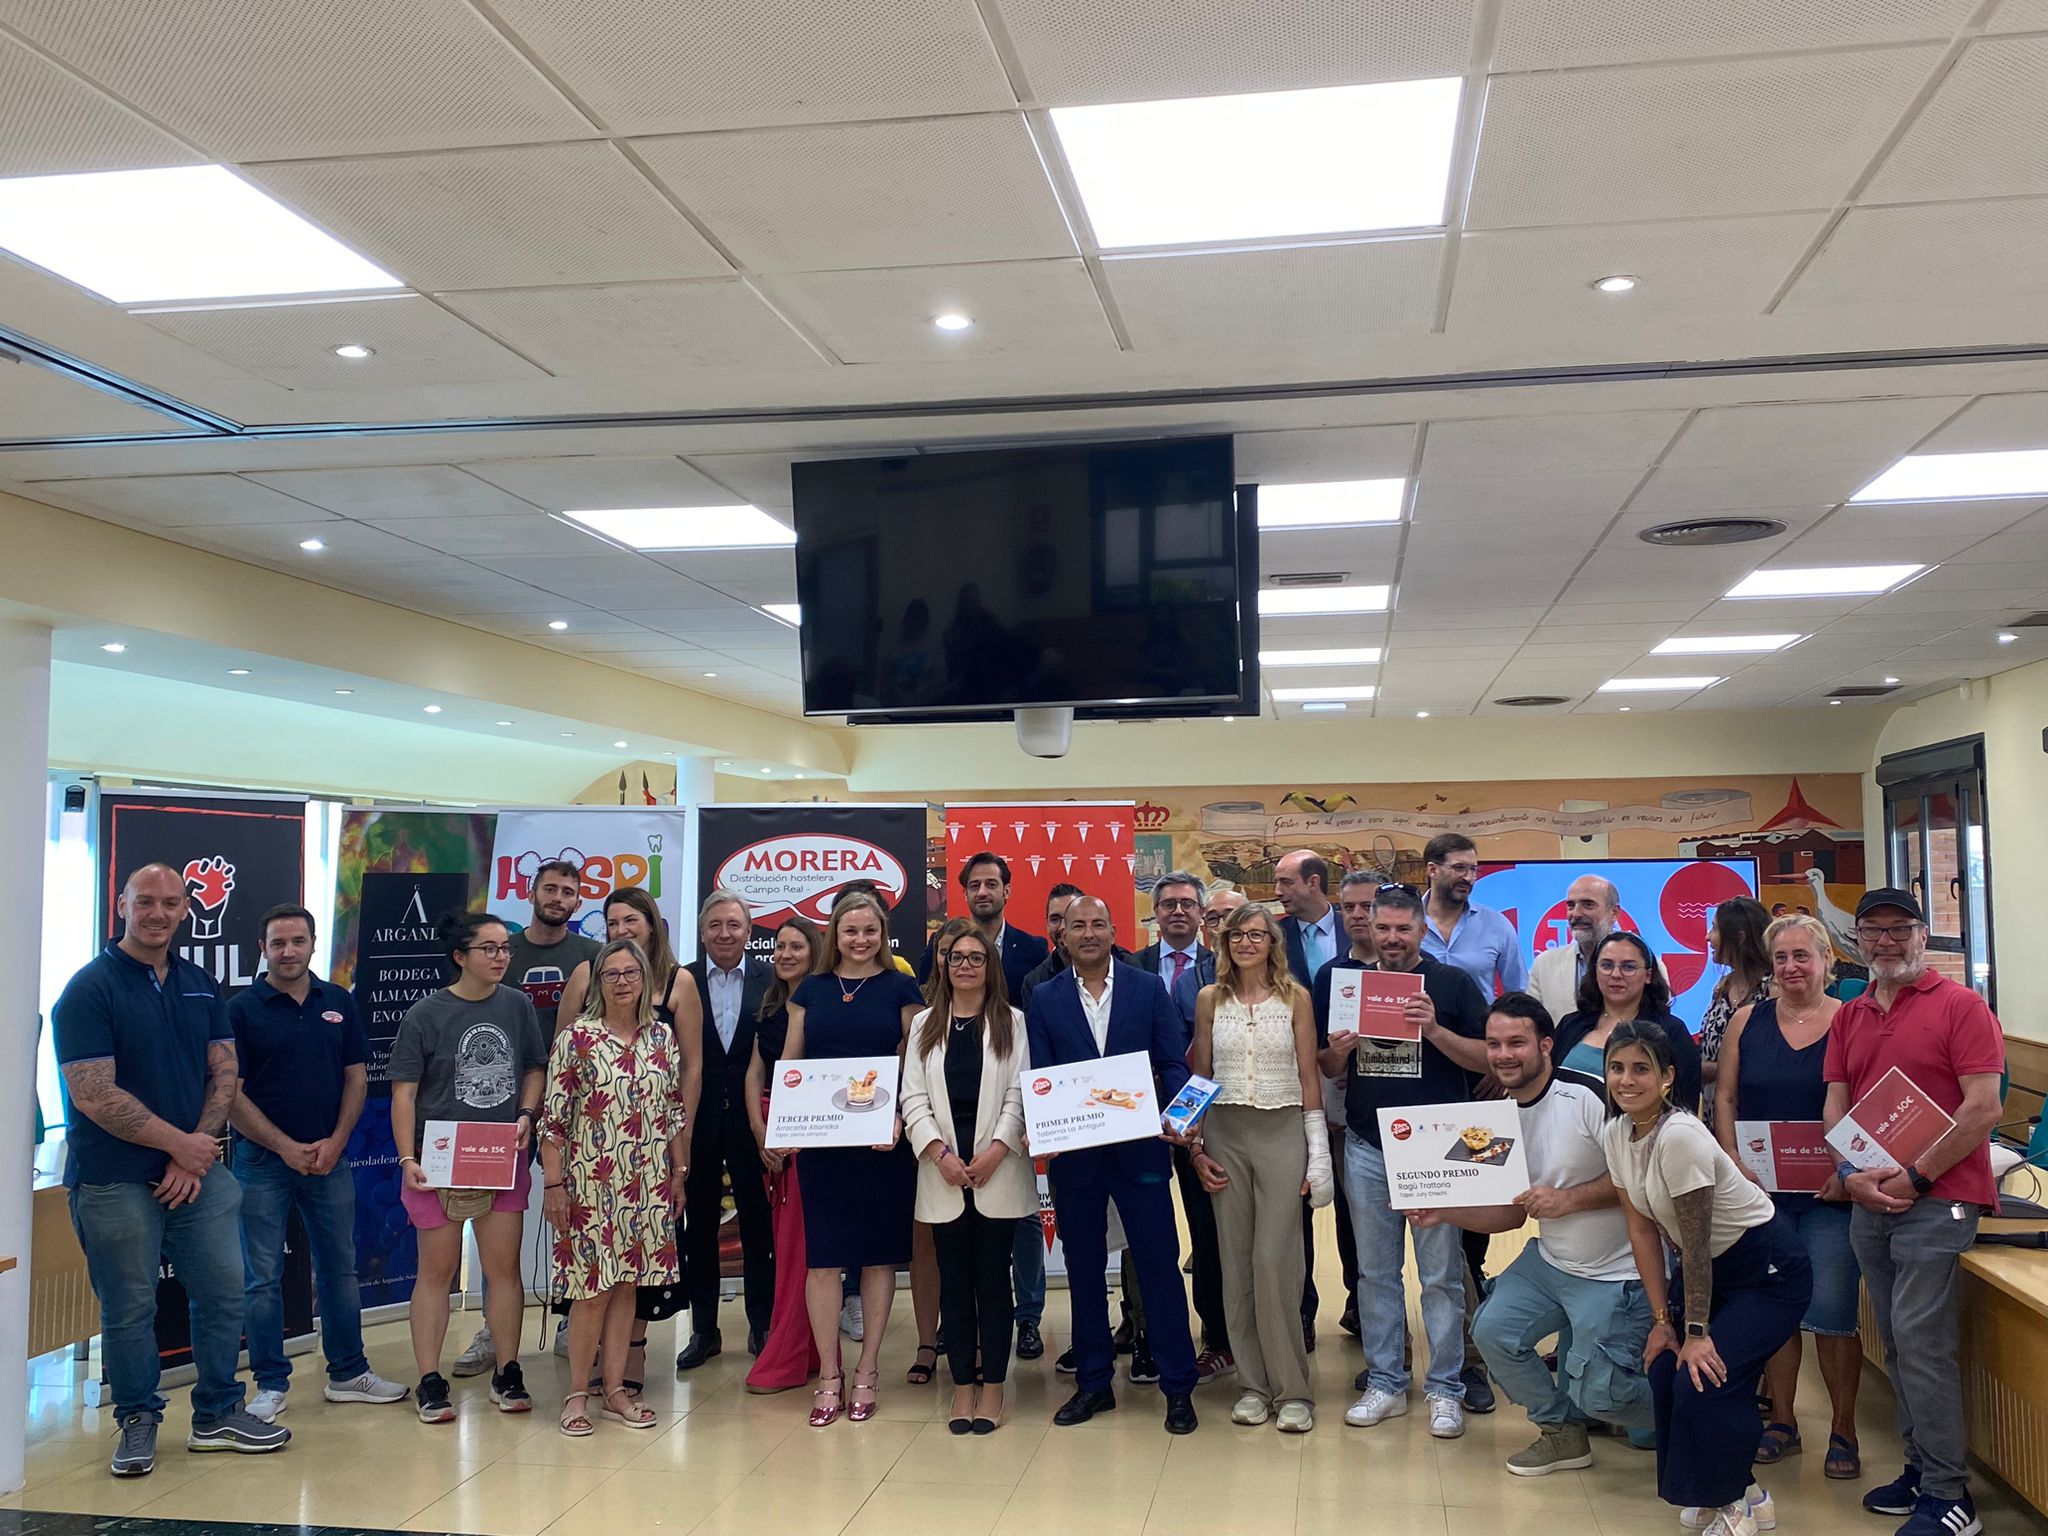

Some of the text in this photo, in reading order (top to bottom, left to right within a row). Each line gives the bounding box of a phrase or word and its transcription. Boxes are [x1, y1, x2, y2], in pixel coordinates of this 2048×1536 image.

[1305, 820, 1320, 830] que
[1690, 811, 1717, 824] futuro
[743, 850, 883, 871] MORERA
[730, 873, 834, 883] Distribución hostelera
[744, 885, 780, 895] Campo
[783, 885, 804, 893] Real
[371, 927, 440, 943] ARGAND
[379, 967, 441, 982] BODEGA
[368, 988, 438, 1003] ALMAZAR
[1366, 995, 1382, 1003] vale
[777, 1113, 844, 1123] TERCER PREMIO
[1035, 1111, 1105, 1129] PRIMER PREMIO
[1874, 1121, 1890, 1135] vale
[1889, 1112, 1899, 1122] de
[1036, 1128, 1067, 1138] Taberna
[1077, 1121, 1106, 1131] Antigua
[1780, 1146, 1797, 1154] vale
[1800, 1146, 1810, 1154] de
[1396, 1168, 1480, 1180] SEGUNDO PREMIO
[1419, 1181, 1452, 1190] Trattoria
